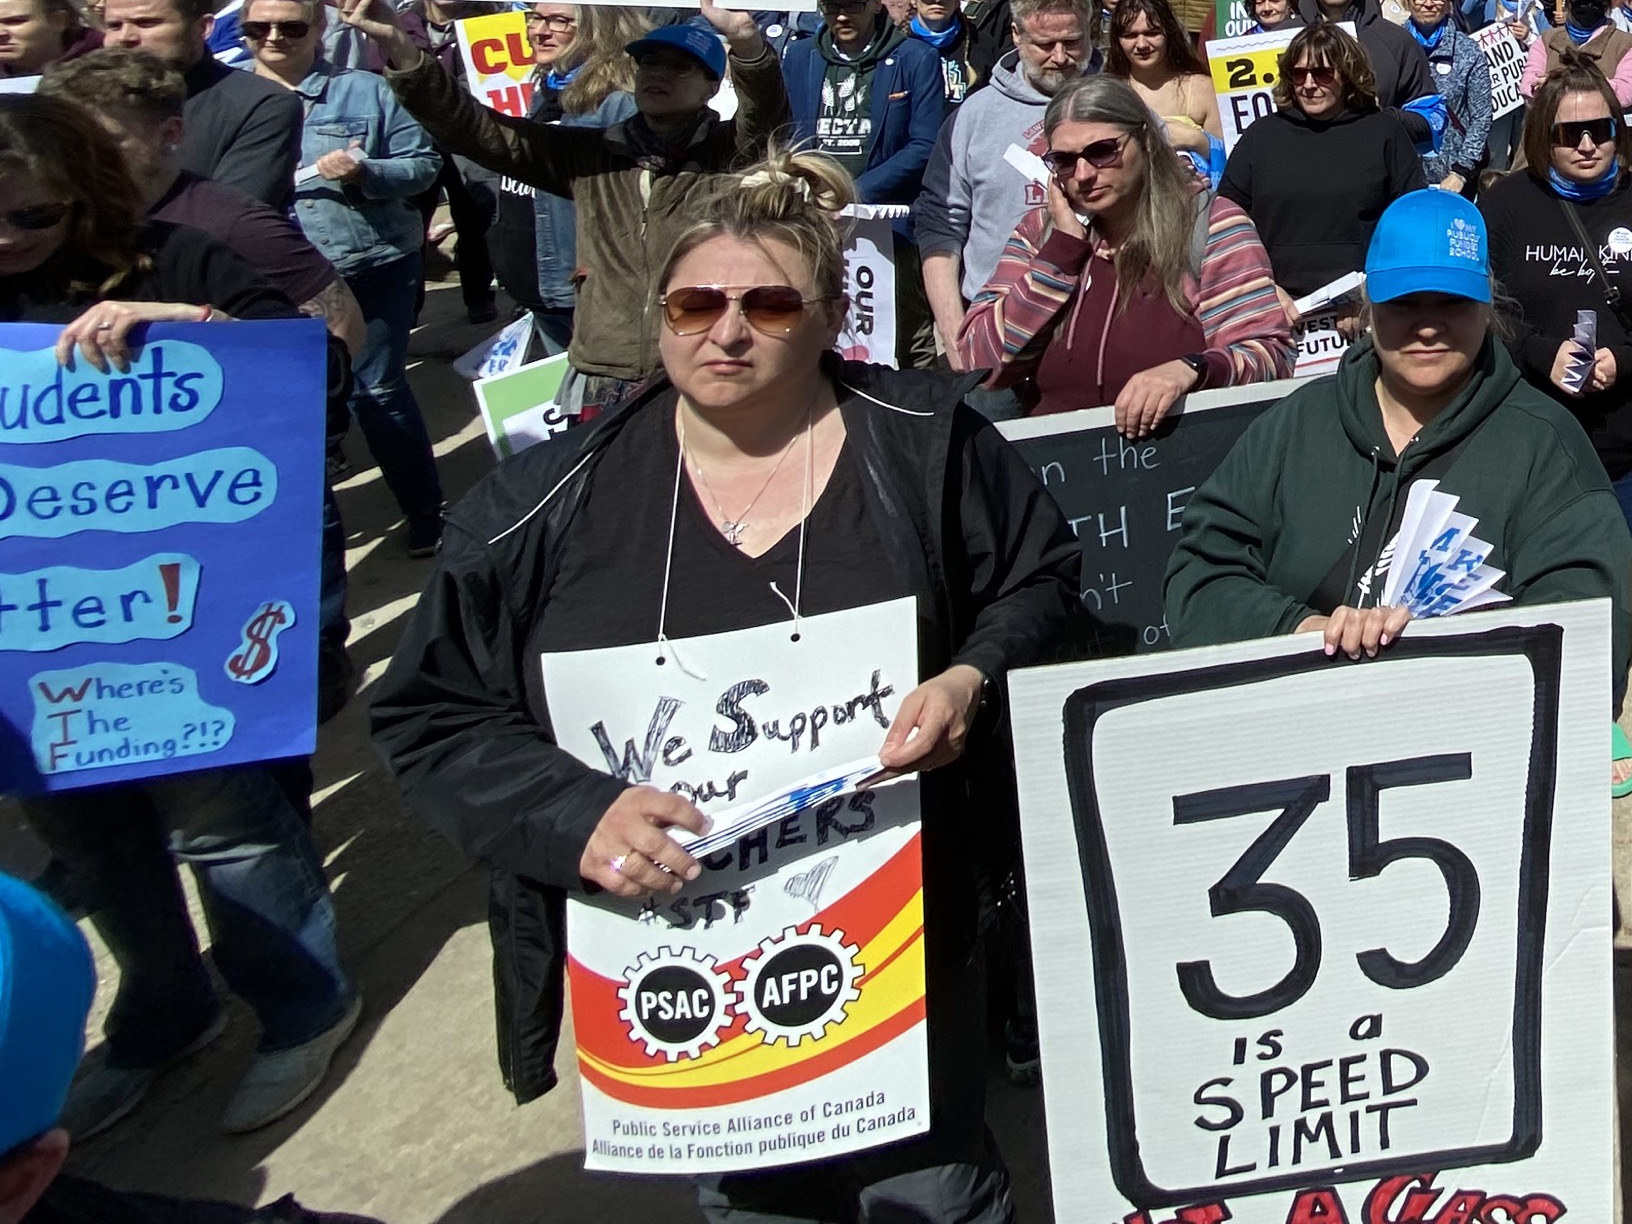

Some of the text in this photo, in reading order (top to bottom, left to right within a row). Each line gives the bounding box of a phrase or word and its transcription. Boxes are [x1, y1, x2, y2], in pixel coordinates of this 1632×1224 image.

[1226, 53, 1285, 89] 2.
[856, 266, 874, 335] OUR
[1093, 436, 1160, 475] the
[49, 709, 132, 747] The
[590, 669, 894, 782] We Support
[1172, 752, 1481, 1019] 35
[639, 989, 710, 1020] PSAC
[762, 964, 839, 1008] AFPC
[1350, 1013, 1382, 1040] a
[1194, 1048, 1430, 1130] SPEED
[592, 1106, 916, 1159] Alliance de la Fonction publique du Canada
[613, 1090, 885, 1137] Public Service Alliance of Canada
[1215, 1098, 1417, 1179] LIMIT
